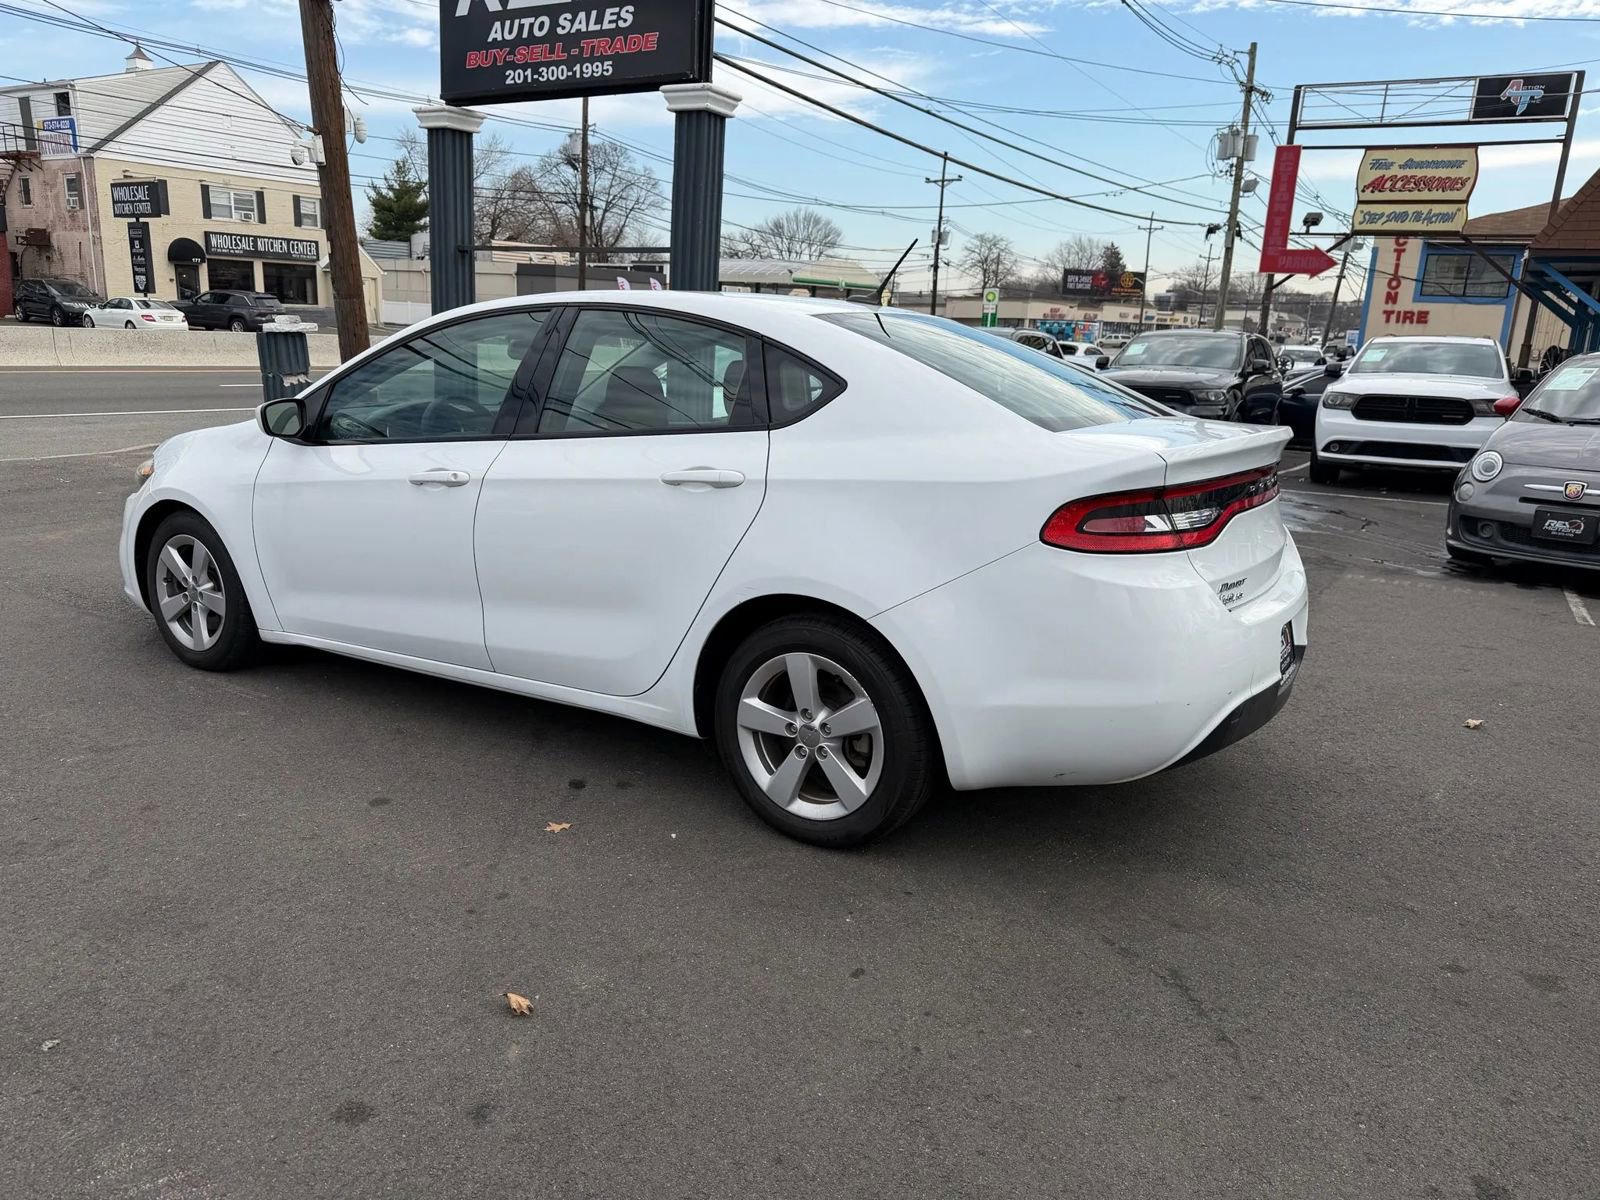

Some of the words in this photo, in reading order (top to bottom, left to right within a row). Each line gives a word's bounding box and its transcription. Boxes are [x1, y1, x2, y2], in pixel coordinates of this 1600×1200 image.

[487, 15, 550, 42] AUTO
[556, 5, 635, 35] SALES
[580, 32, 660, 57] TRADE
[505, 61, 613, 85] 201-300-1995
[112, 185, 150, 201] WHOLESALE
[1361, 174, 1471, 193] ACCESSORIES
[114, 203, 133, 214] KITCHEN
[133, 202, 152, 214] CENTER
[209, 233, 255, 251] WHOLESALE
[257, 237, 288, 254] KITCHEN
[289, 240, 317, 256] CENTER
[1382, 310, 1430, 324] TIRE
